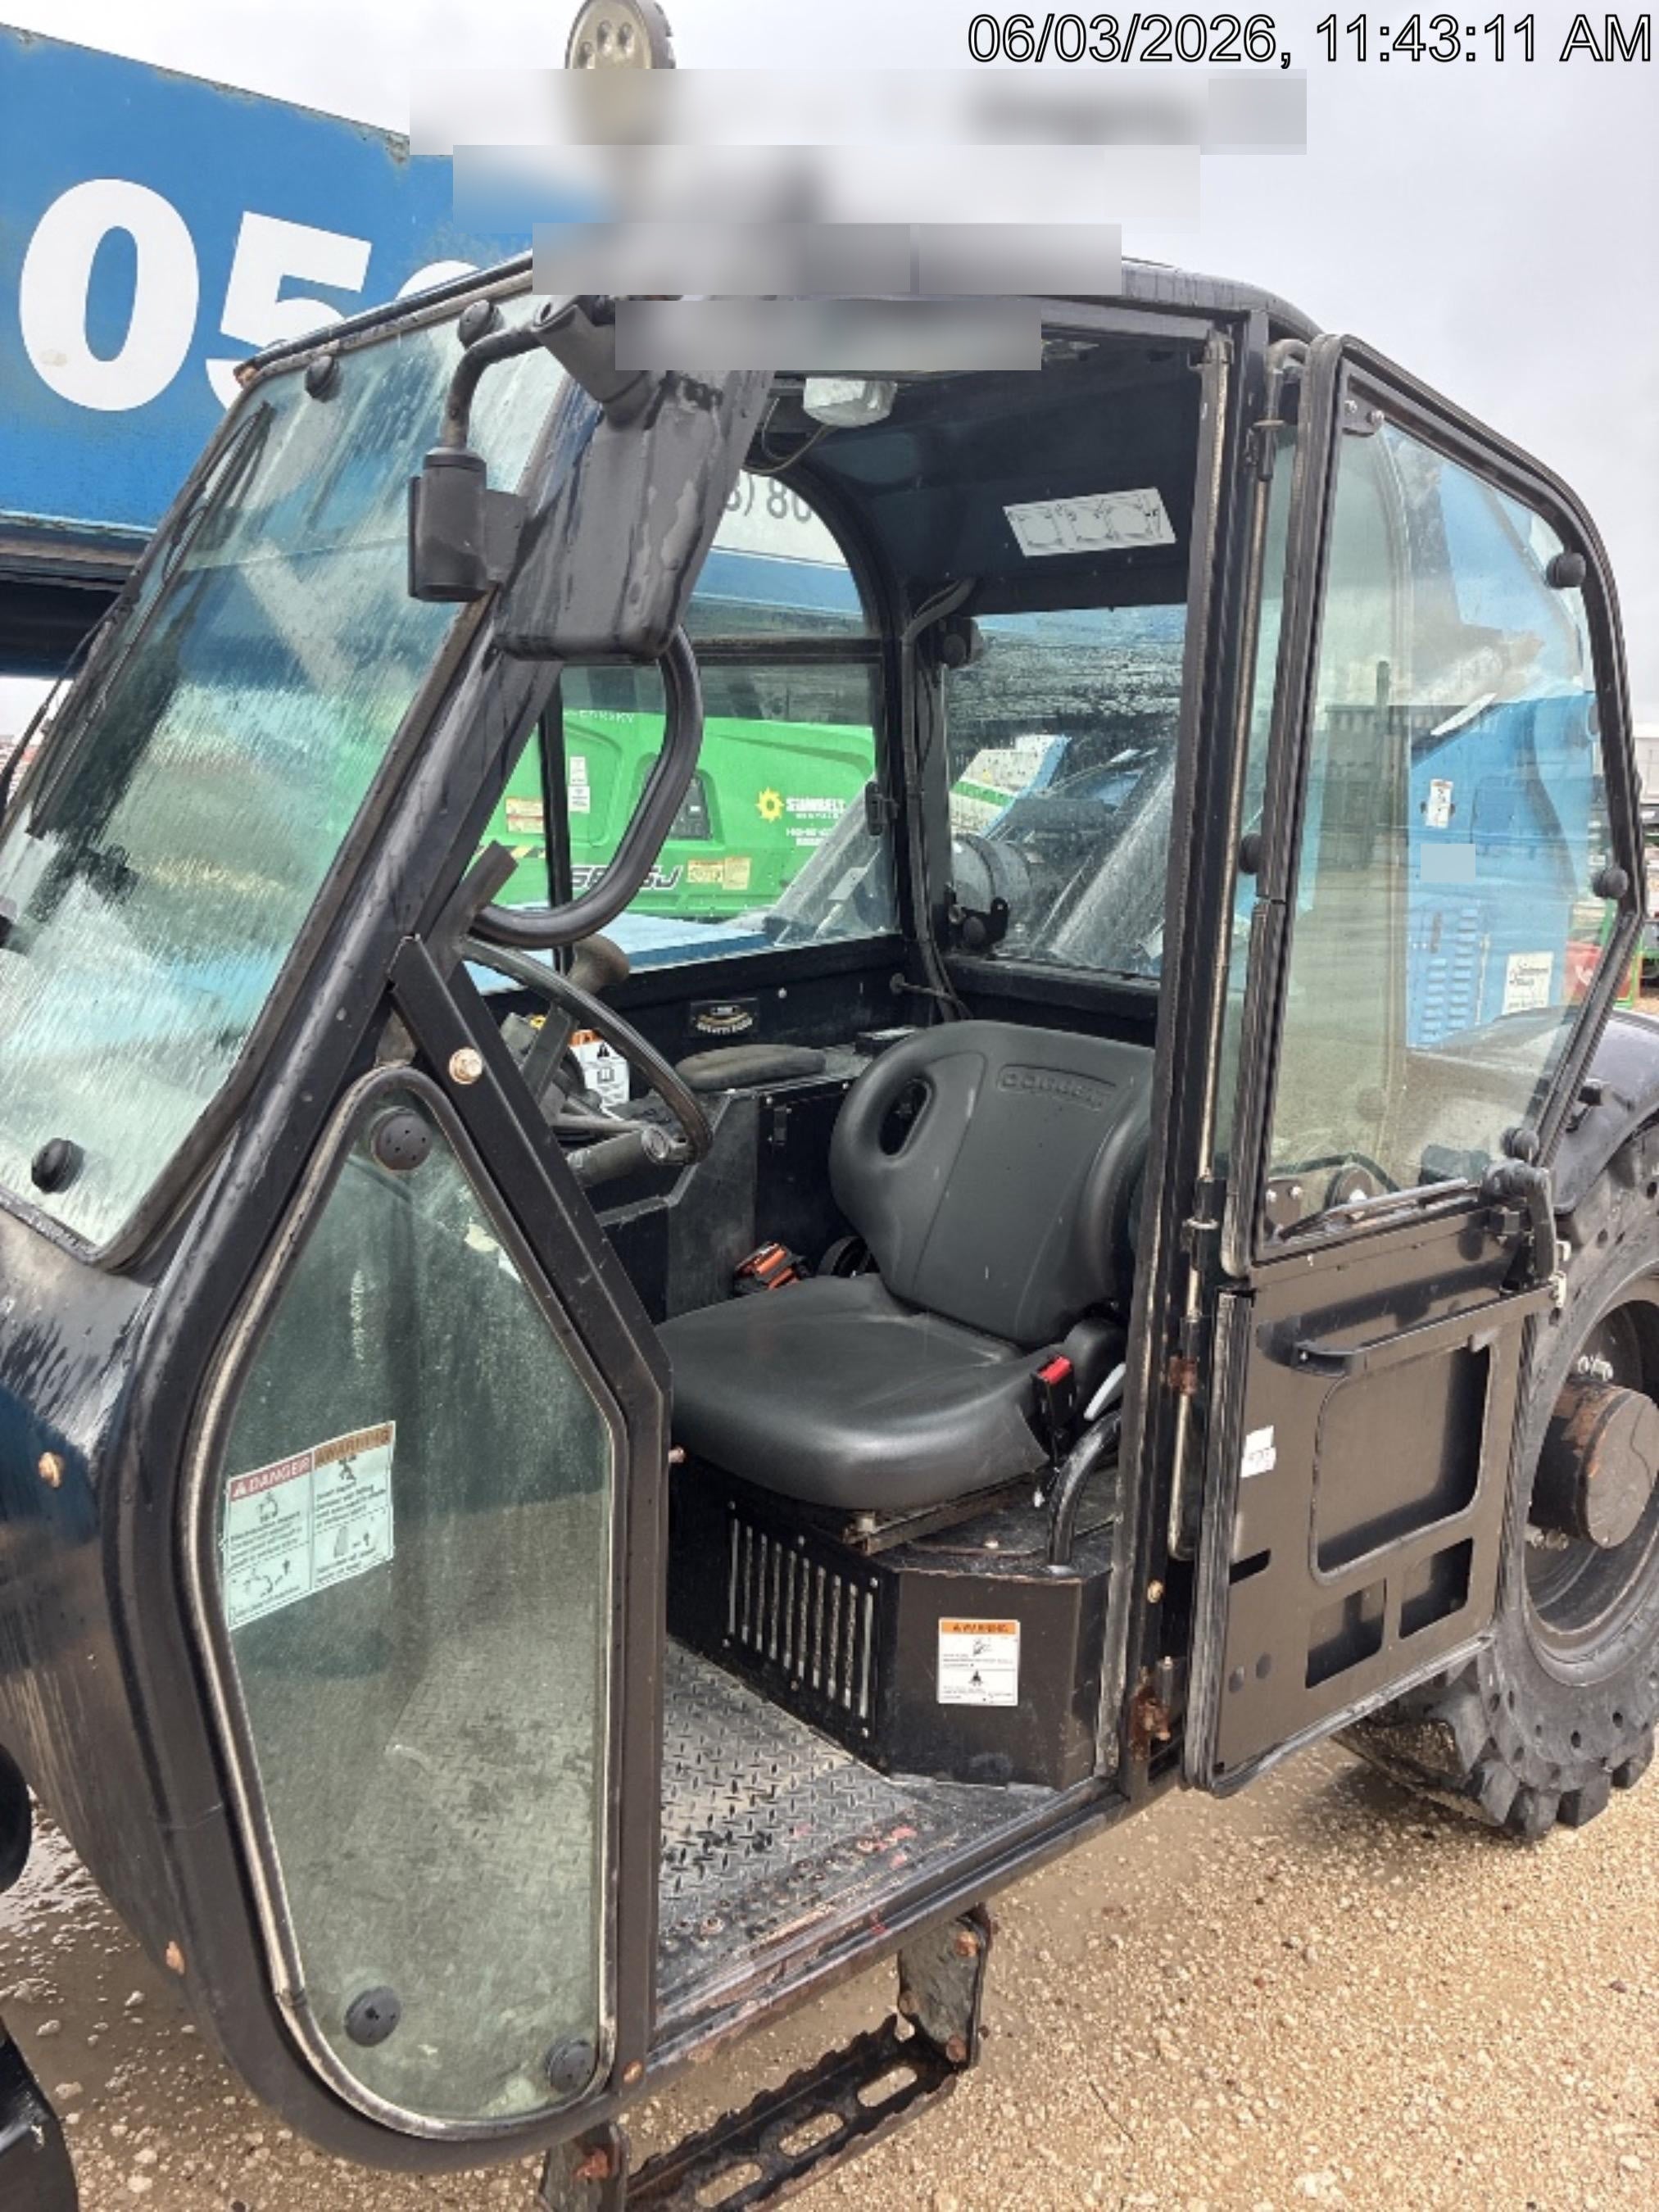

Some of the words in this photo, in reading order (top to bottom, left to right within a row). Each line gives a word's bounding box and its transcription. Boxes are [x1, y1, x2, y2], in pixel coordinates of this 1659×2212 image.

[19, 178, 479, 411] 05
[323, 1429, 389, 1463] WARNING
[249, 1457, 309, 1493] DANGER
